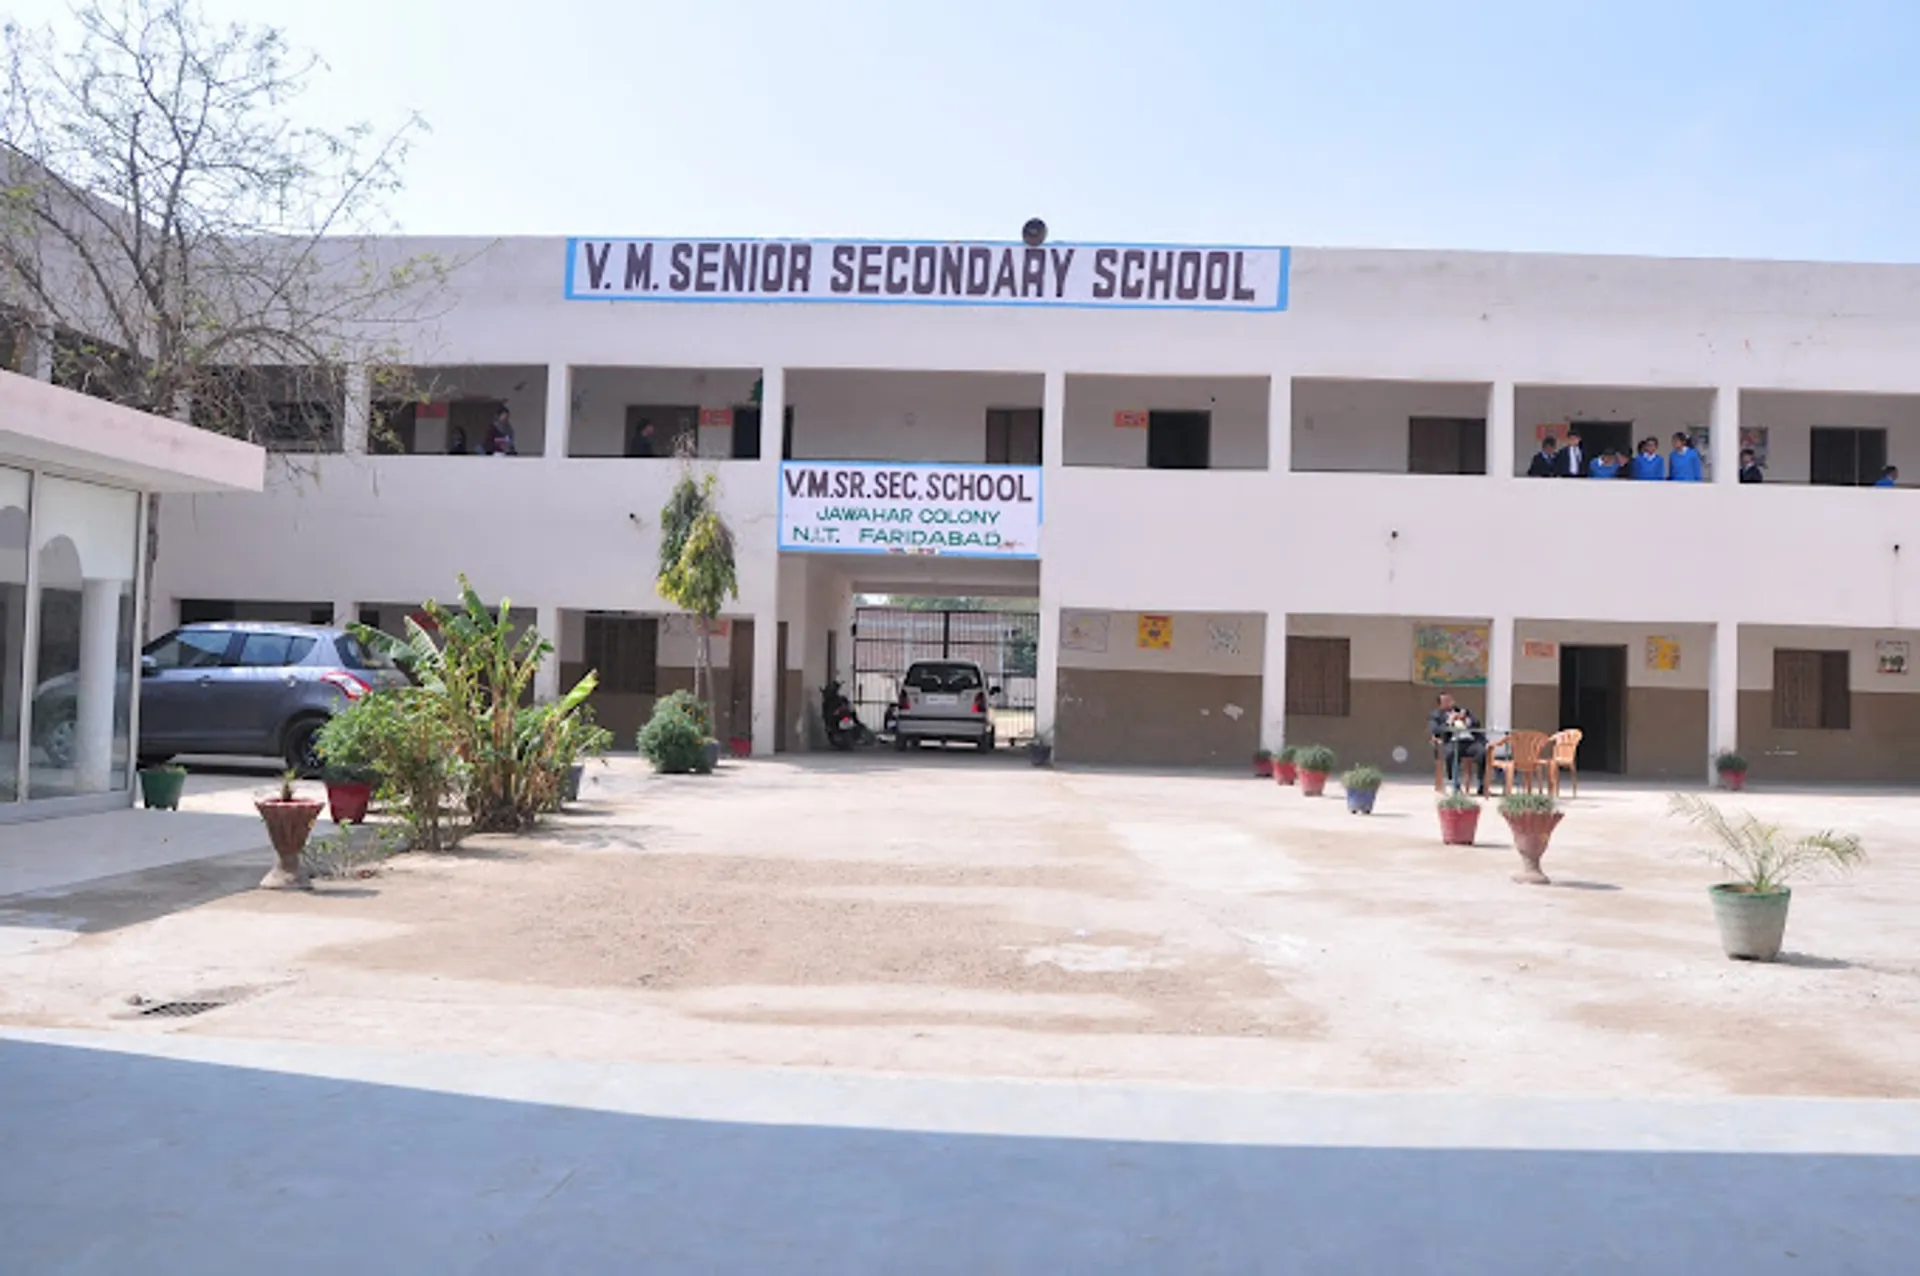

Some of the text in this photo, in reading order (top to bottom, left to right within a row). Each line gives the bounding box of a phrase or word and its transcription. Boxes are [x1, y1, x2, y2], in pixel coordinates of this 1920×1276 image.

[669, 243, 812, 293] SENIOR
[830, 246, 1075, 298] SECONDARY
[1093, 249, 1256, 301] SCHOOL
[816, 505, 1001, 525] JAWAHAR COLONY
[859, 527, 1001, 547] FARIDABAD
